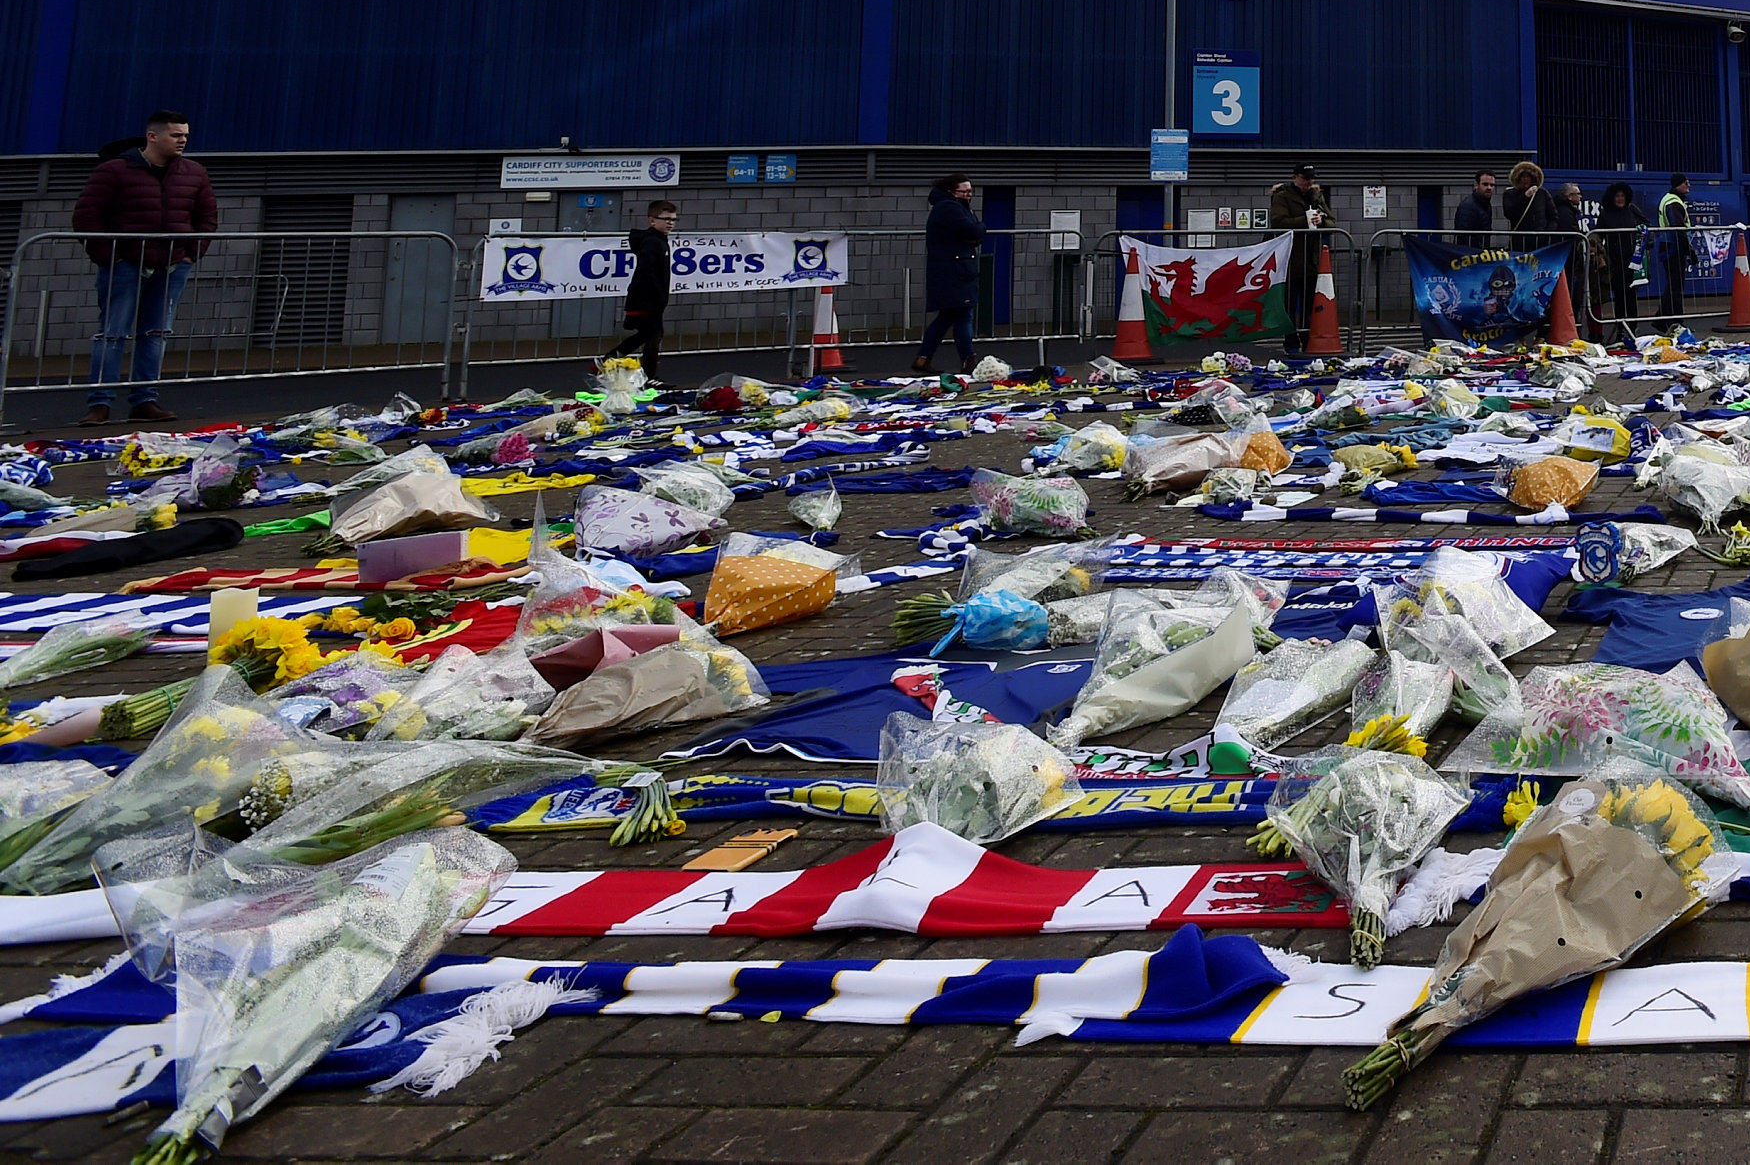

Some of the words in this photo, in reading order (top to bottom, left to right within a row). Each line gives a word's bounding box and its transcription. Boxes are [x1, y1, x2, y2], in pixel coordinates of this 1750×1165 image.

[1211, 79, 1243, 126] 3
[696, 281, 723, 289] WITH
[727, 280, 739, 288] US
[1423, 276, 1455, 285] CASUAL
[595, 283, 620, 292] WILL
[1431, 538, 1577, 547] FRANC
